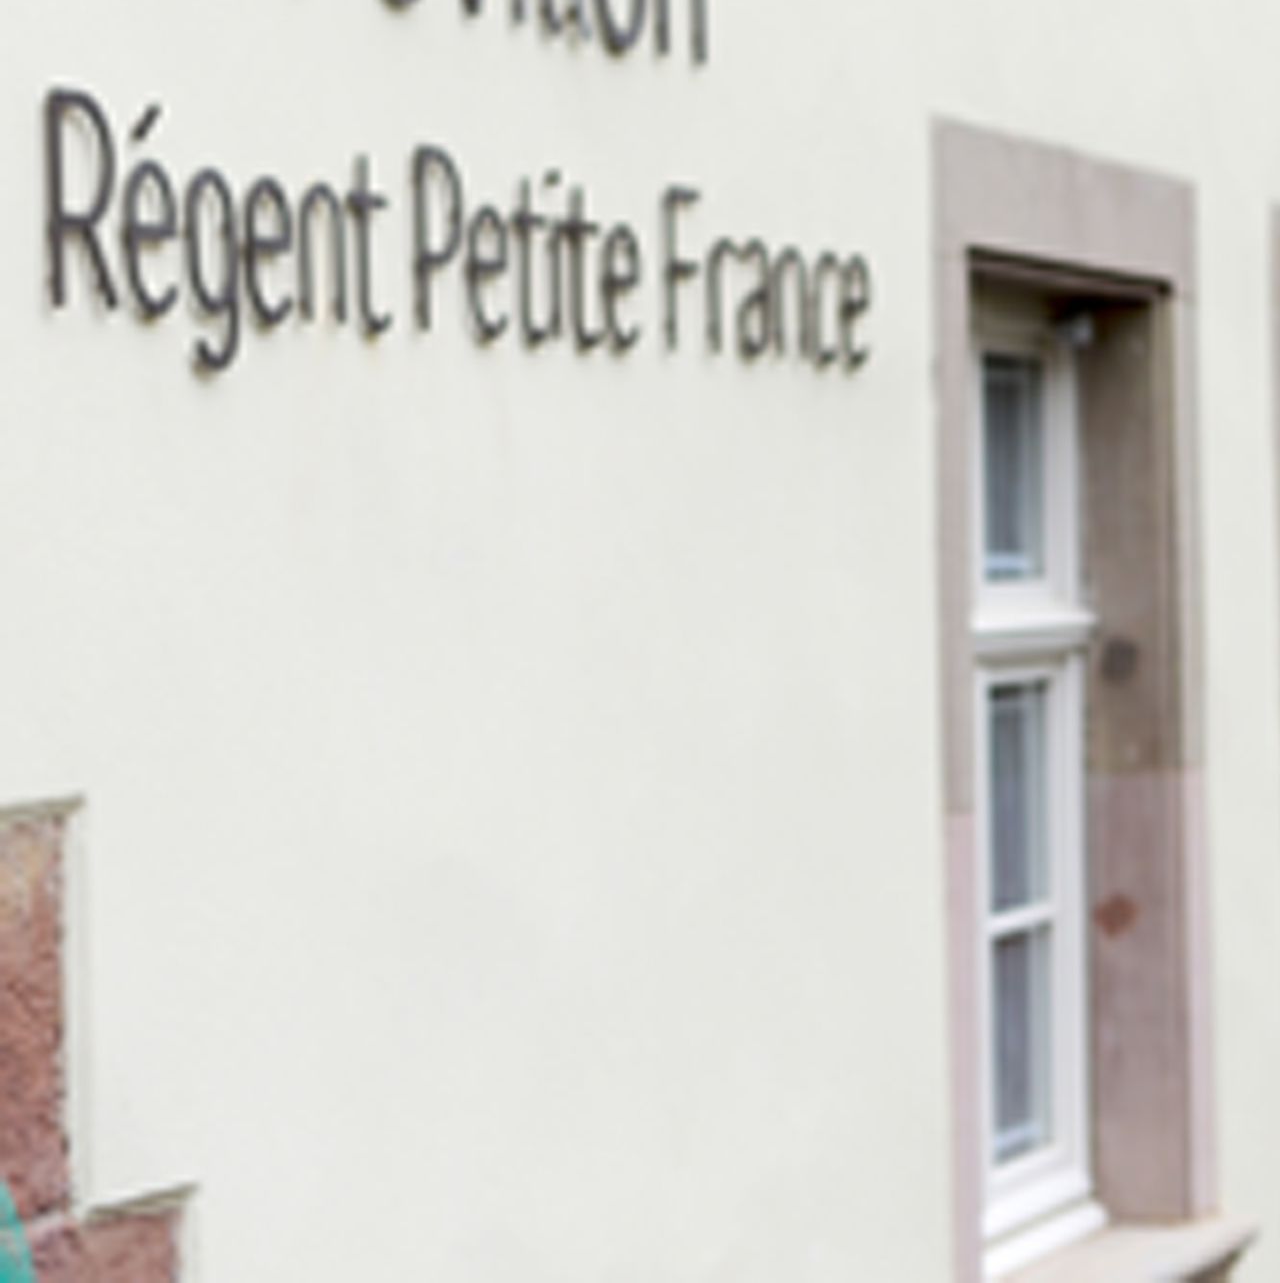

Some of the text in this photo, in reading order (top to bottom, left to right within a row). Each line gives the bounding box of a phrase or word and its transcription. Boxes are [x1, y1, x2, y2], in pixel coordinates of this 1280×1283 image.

[43, 87, 871, 378] Régent Petite France
